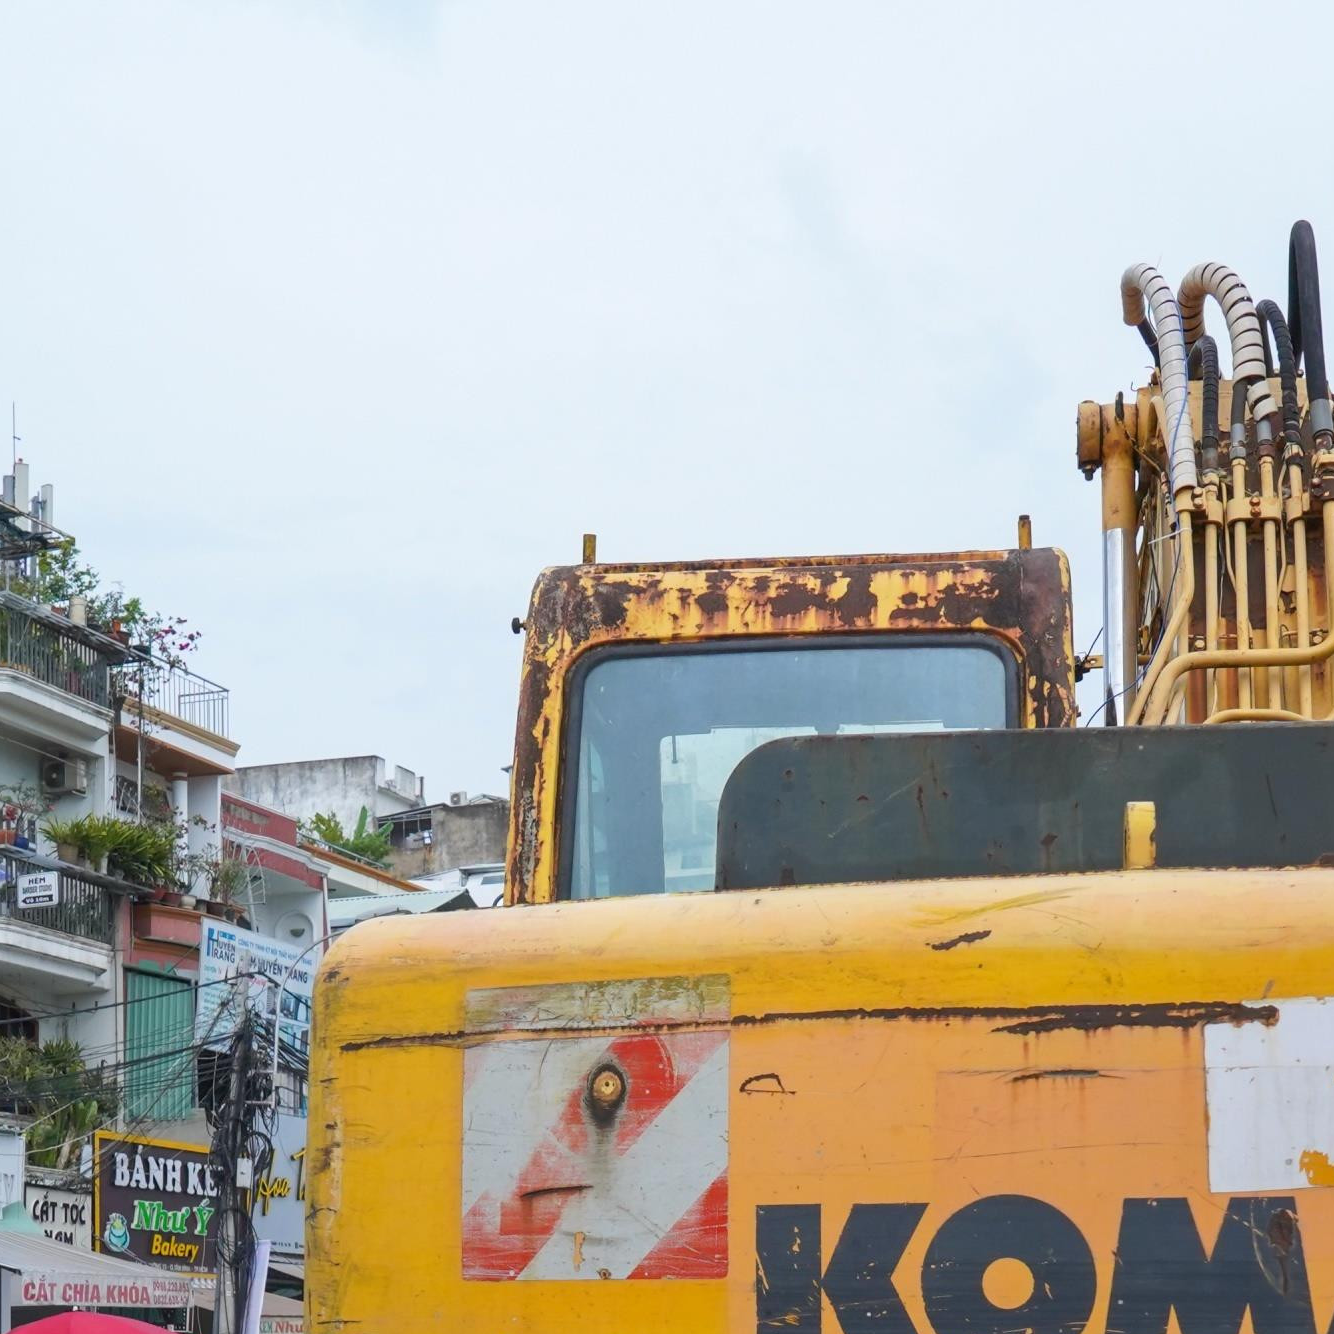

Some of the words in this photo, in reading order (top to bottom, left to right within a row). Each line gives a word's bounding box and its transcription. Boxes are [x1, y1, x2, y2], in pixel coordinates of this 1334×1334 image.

[114, 1145, 182, 1193] BÁNH
[32, 1191, 58, 1223] CẮT
[62, 1198, 86, 1225] TÓC
[131, 1200, 191, 1233] Như
[193, 1198, 215, 1236] Ý
[151, 1234, 199, 1263] Bakery
[23, 1275, 58, 1302] CẮT
[62, 1280, 102, 1304] CHÌA
[106, 1282, 151, 1305] KHÓA
